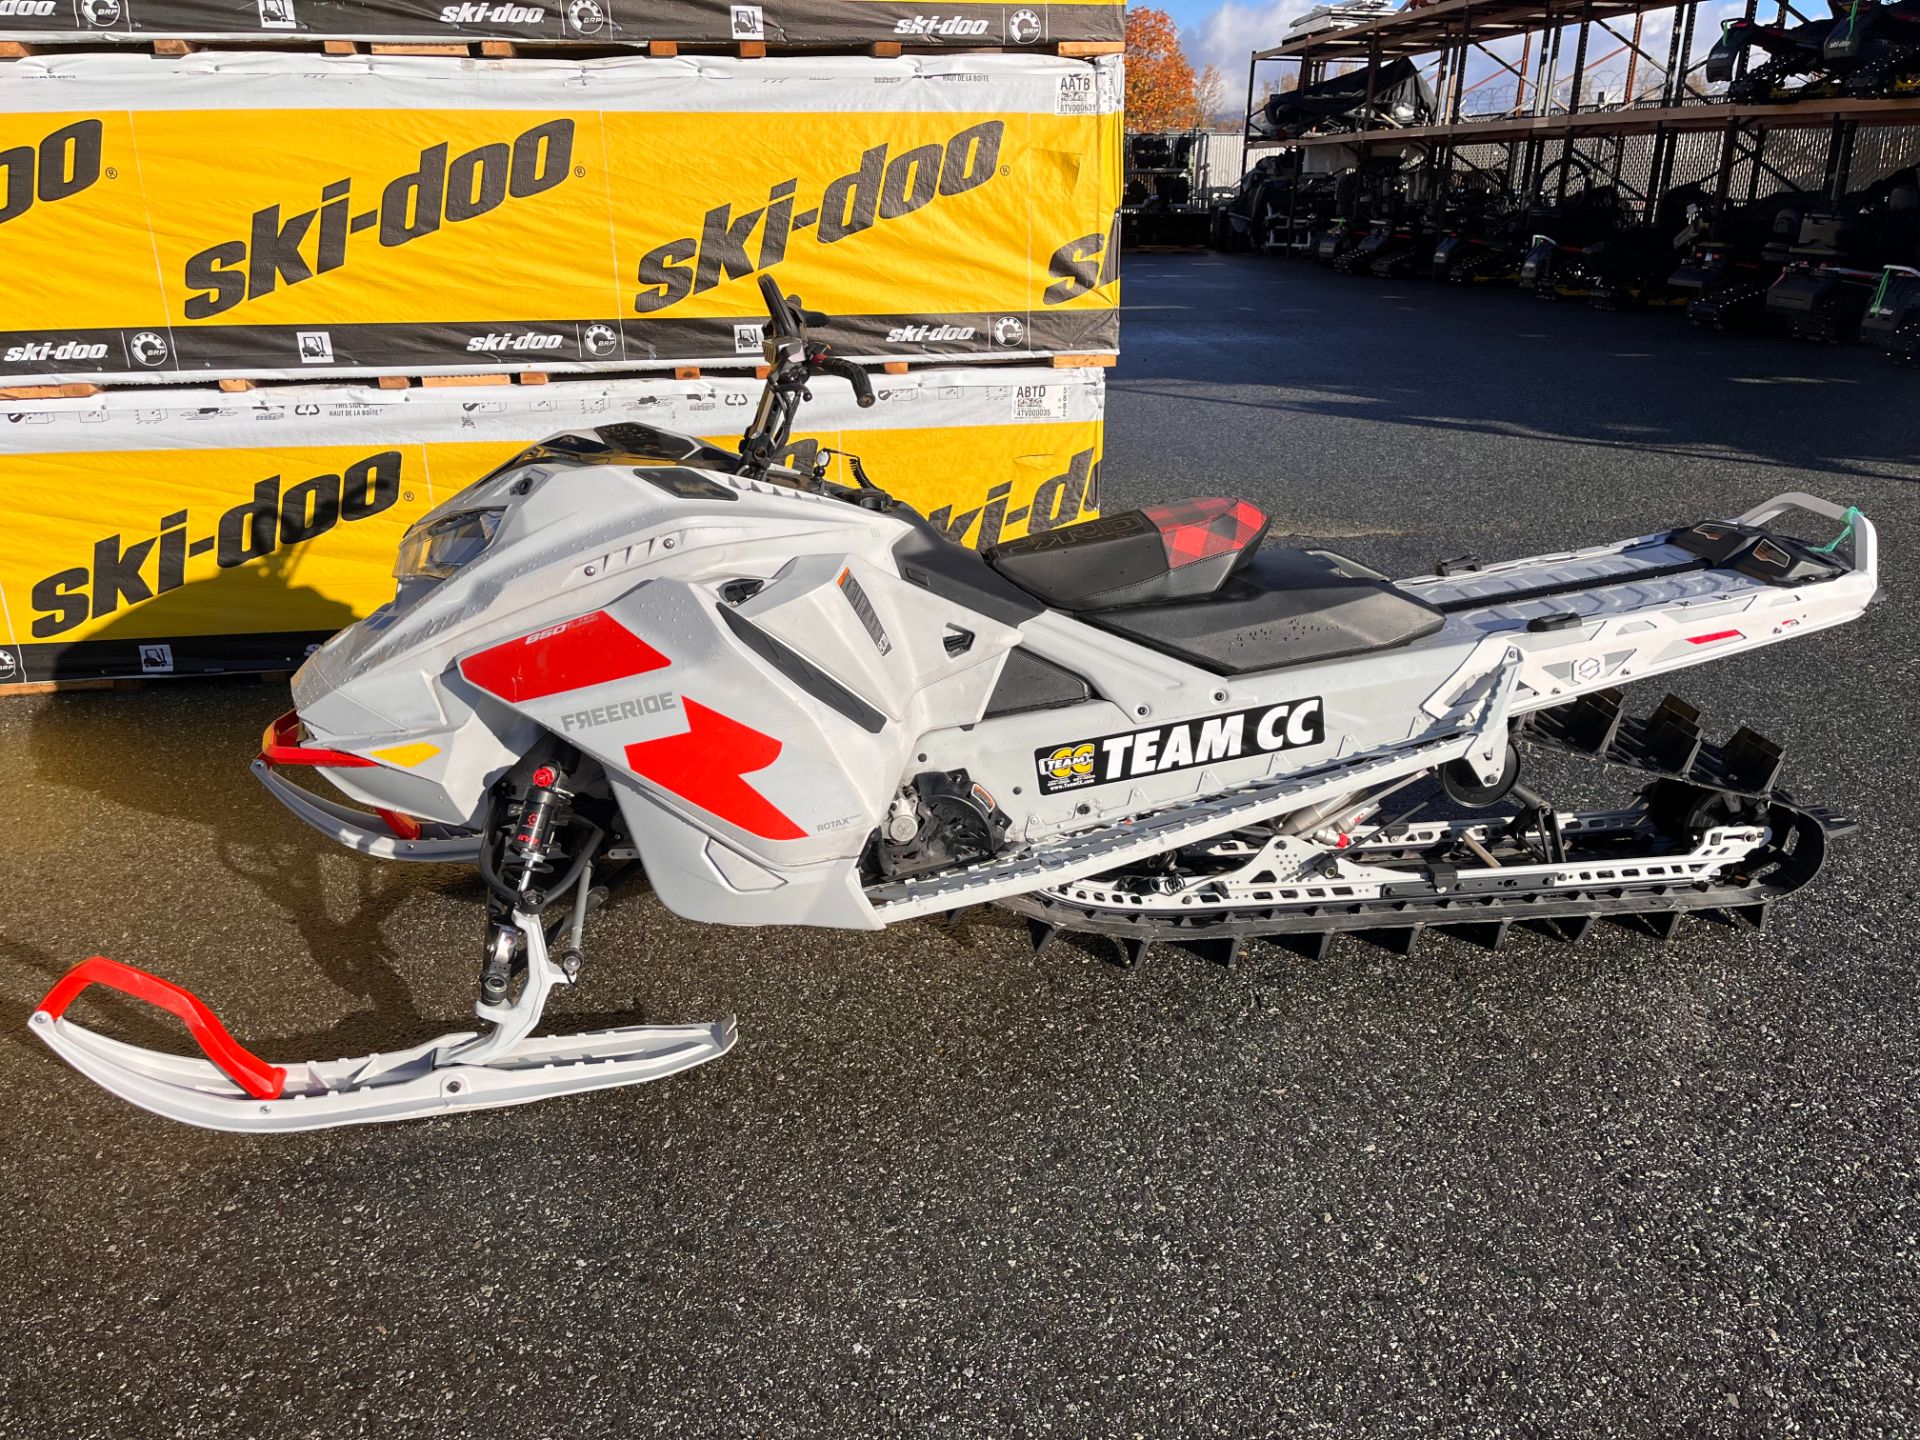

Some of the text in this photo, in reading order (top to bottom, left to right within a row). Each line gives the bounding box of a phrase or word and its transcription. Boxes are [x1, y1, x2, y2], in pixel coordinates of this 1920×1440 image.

[440, 2, 545, 24] ski-doo
[893, 16, 990, 35] ski-doo
[1060, 77, 1090, 91] AATB
[184, 118, 576, 320] ski-doo
[635, 120, 1005, 313] ski-doo
[466, 332, 564, 351] ski-doo
[886, 325, 976, 342] ski-doo
[4, 341, 108, 362] ski-doo
[1016, 385, 1046, 398] ABTD
[31, 450, 403, 638] ski-doo
[524, 624, 567, 645] 850
[561, 691, 677, 733] FREERIDE
[1102, 699, 1320, 780] TEAM CC
[1047, 756, 1087, 772] TEAM
[816, 816, 850, 832] ROTAX
